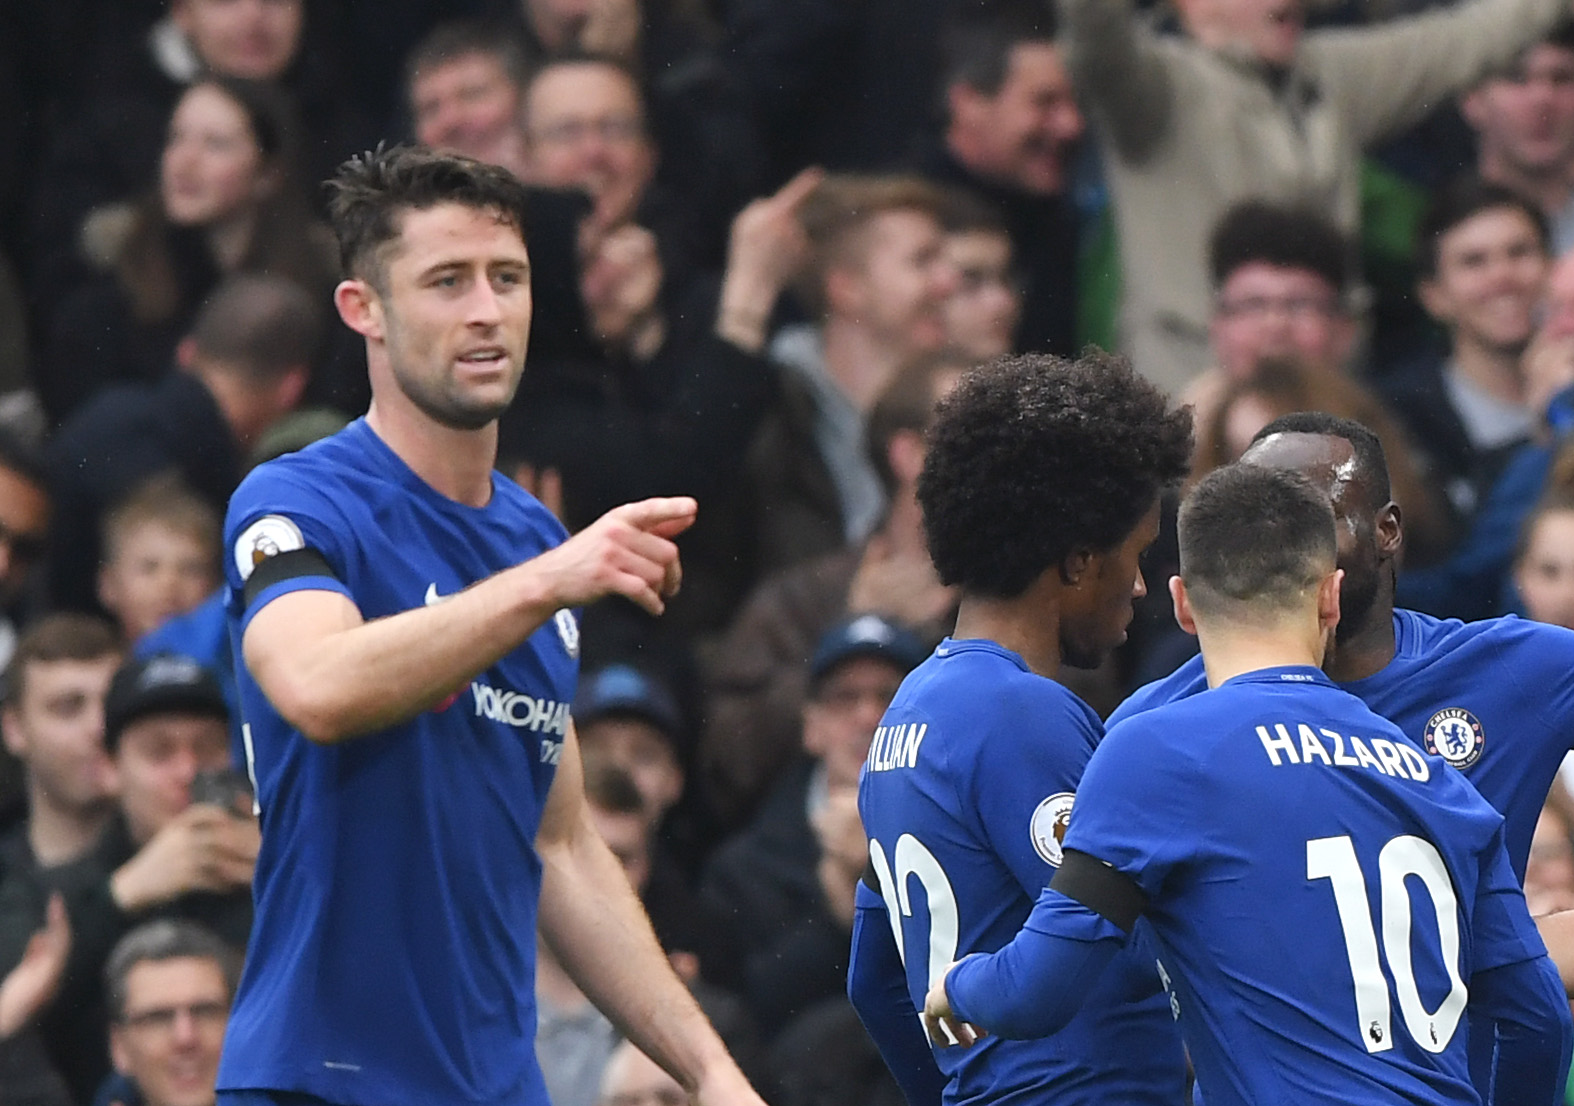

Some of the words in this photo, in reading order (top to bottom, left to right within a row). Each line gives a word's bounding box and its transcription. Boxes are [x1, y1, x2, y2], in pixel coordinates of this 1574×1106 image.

[1430, 710, 1468, 728] CHELSEA
[867, 722, 928, 773] ILLIAN
[1256, 724, 1430, 782] HAZARD
[1306, 834, 1468, 1054] 10
